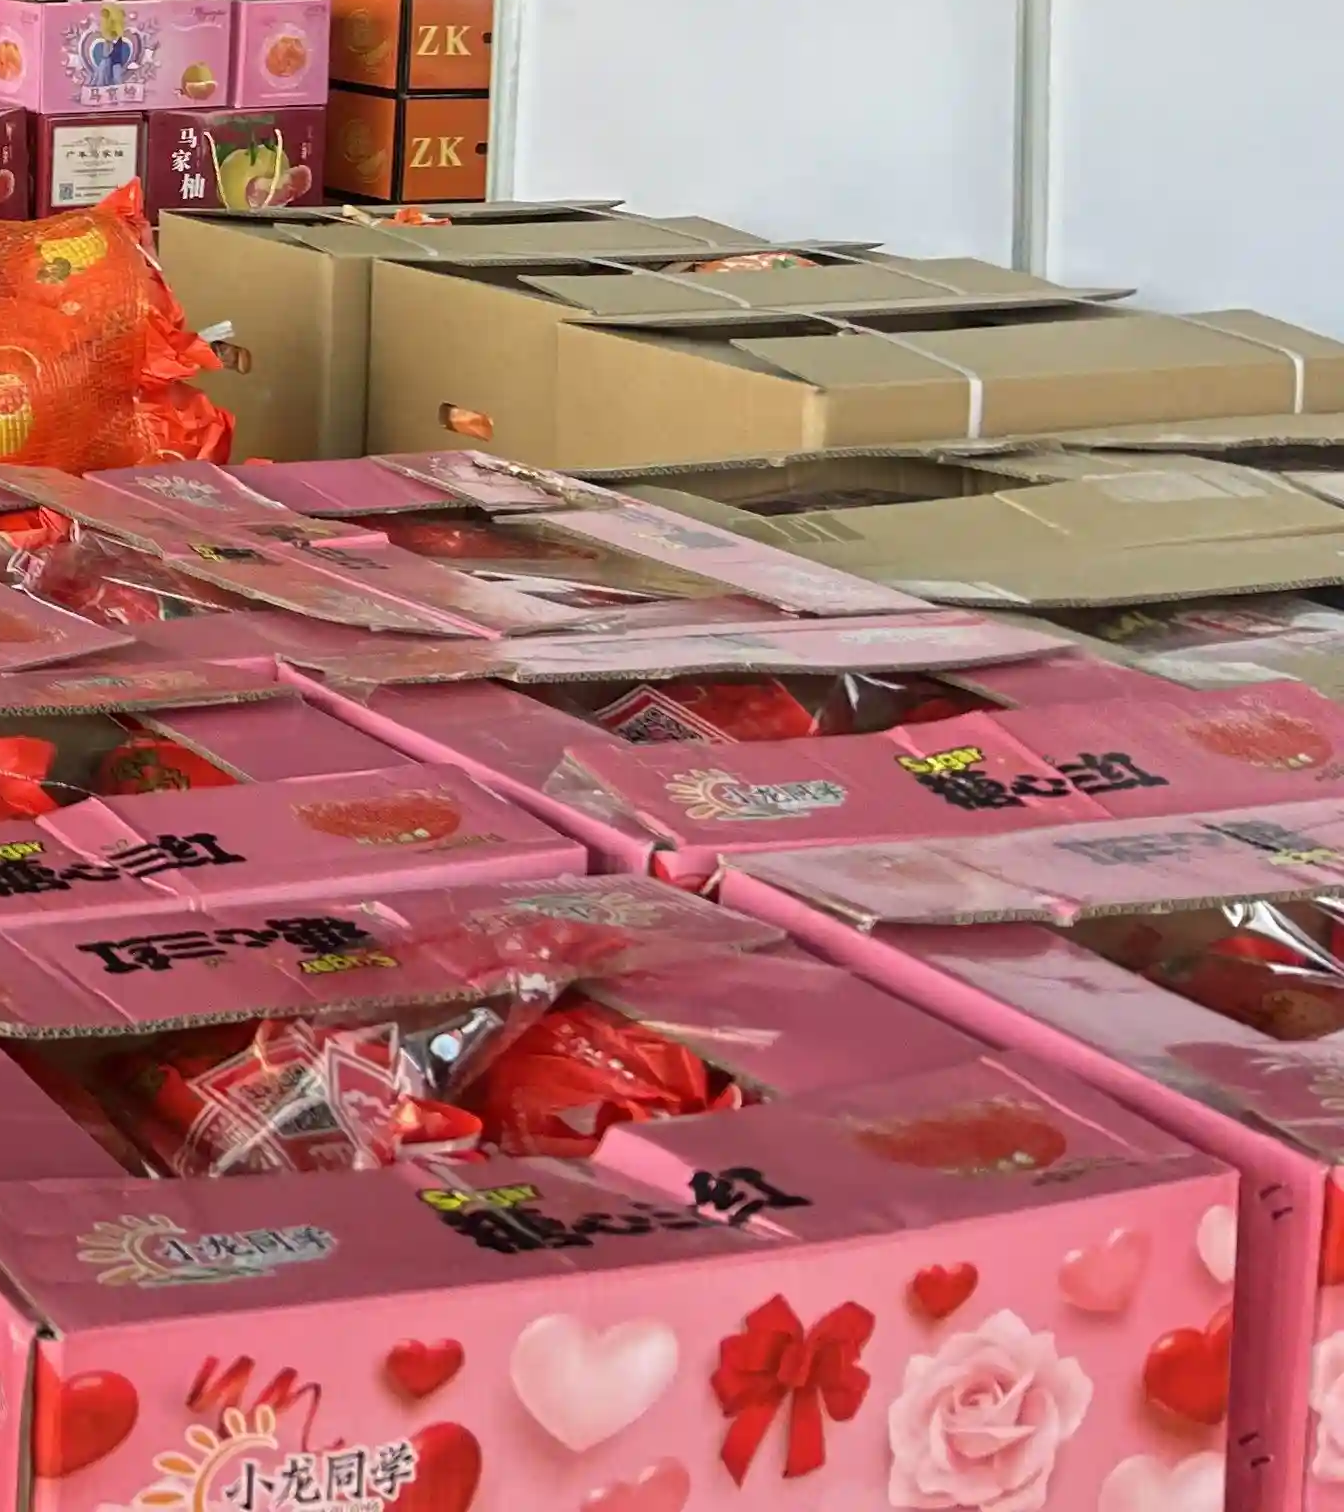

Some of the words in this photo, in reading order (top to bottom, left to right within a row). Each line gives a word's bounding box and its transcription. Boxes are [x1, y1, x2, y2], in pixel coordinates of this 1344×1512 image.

[416, 25, 472, 56] ZK
[171, 127, 206, 200] 马家柚
[409, 137, 465, 168] ZK
[298, 950, 400, 974] Sugar
[160, 1227, 337, 1268] 小龙同学
[224, 1440, 417, 1511] 小龙同学
